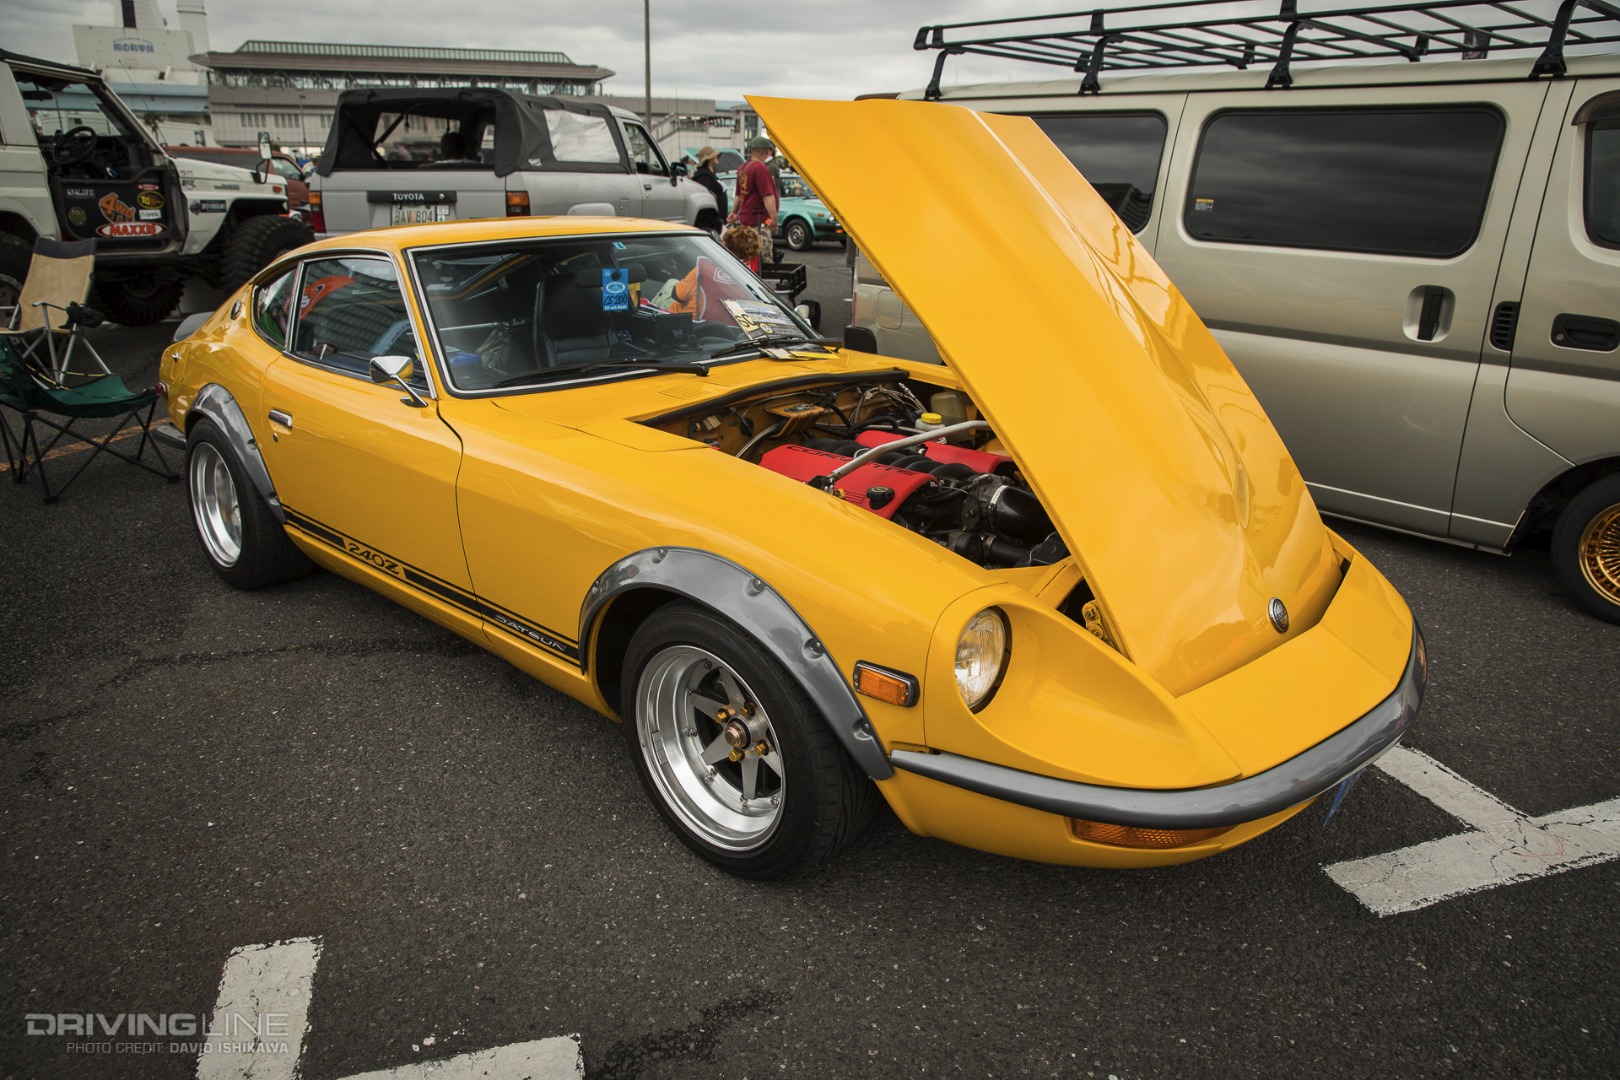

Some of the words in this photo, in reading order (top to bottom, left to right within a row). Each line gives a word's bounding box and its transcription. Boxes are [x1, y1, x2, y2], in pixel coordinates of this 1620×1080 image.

[416, 211, 432, 222] 804
[787, 446, 913, 476] CORVTTE
[348, 542, 400, 575] 240Z
[494, 614, 567, 651] DATSUN
